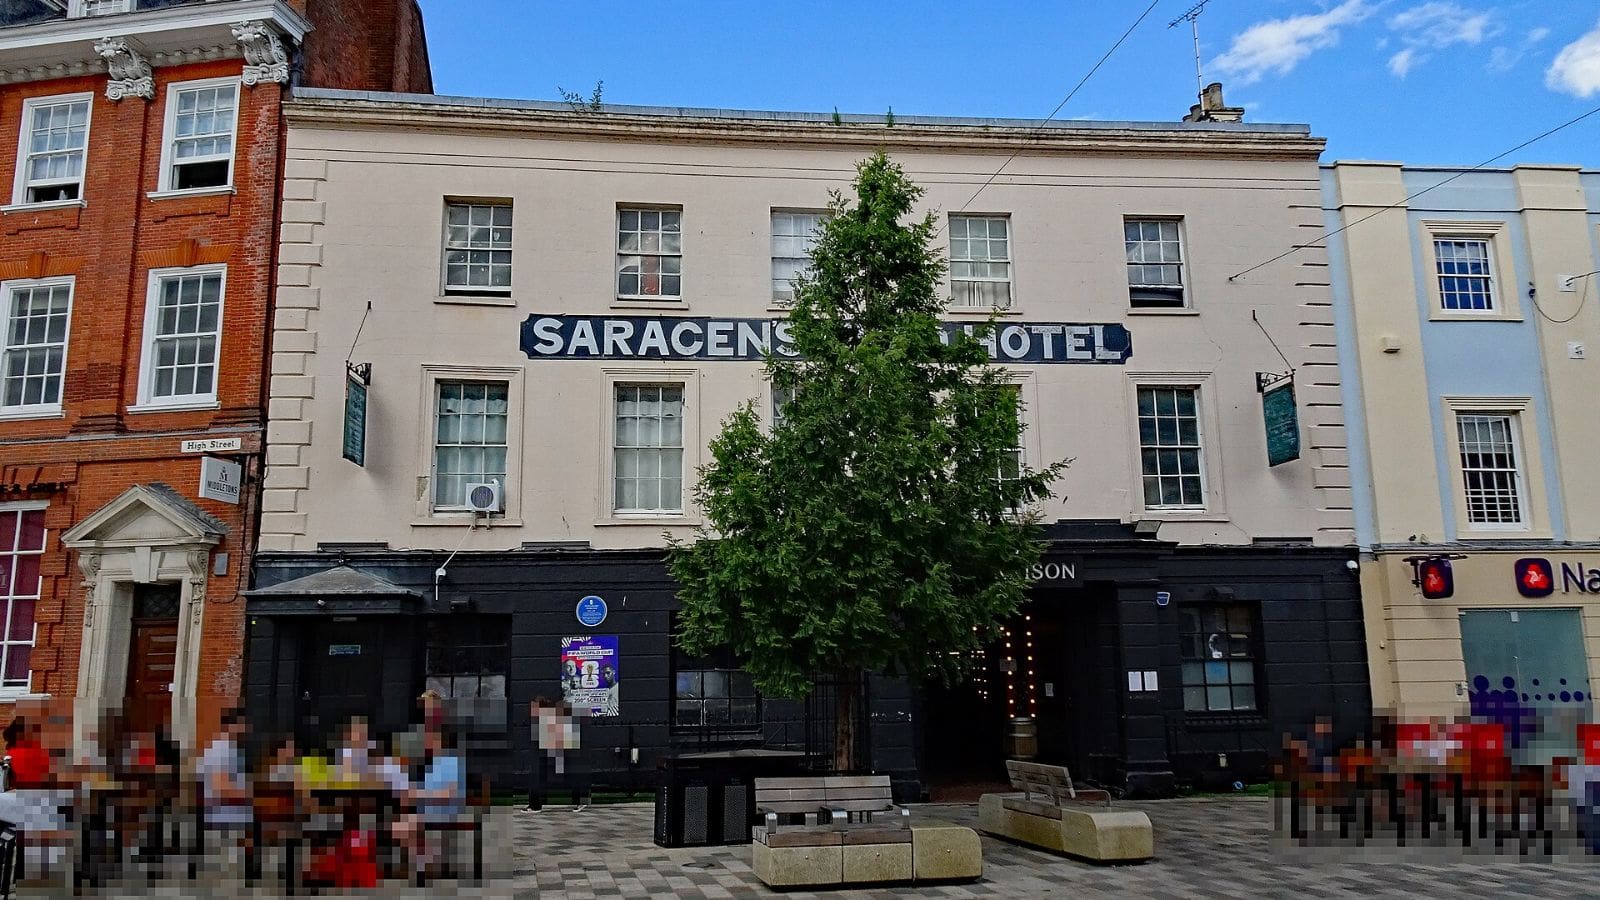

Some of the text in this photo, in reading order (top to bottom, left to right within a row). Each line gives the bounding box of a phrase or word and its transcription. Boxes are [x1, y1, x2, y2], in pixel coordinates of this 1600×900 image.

[964, 324, 1121, 360] HOTEL
[187, 440, 235, 451] High Street
[207, 480, 238, 495] MIDDLETONS
